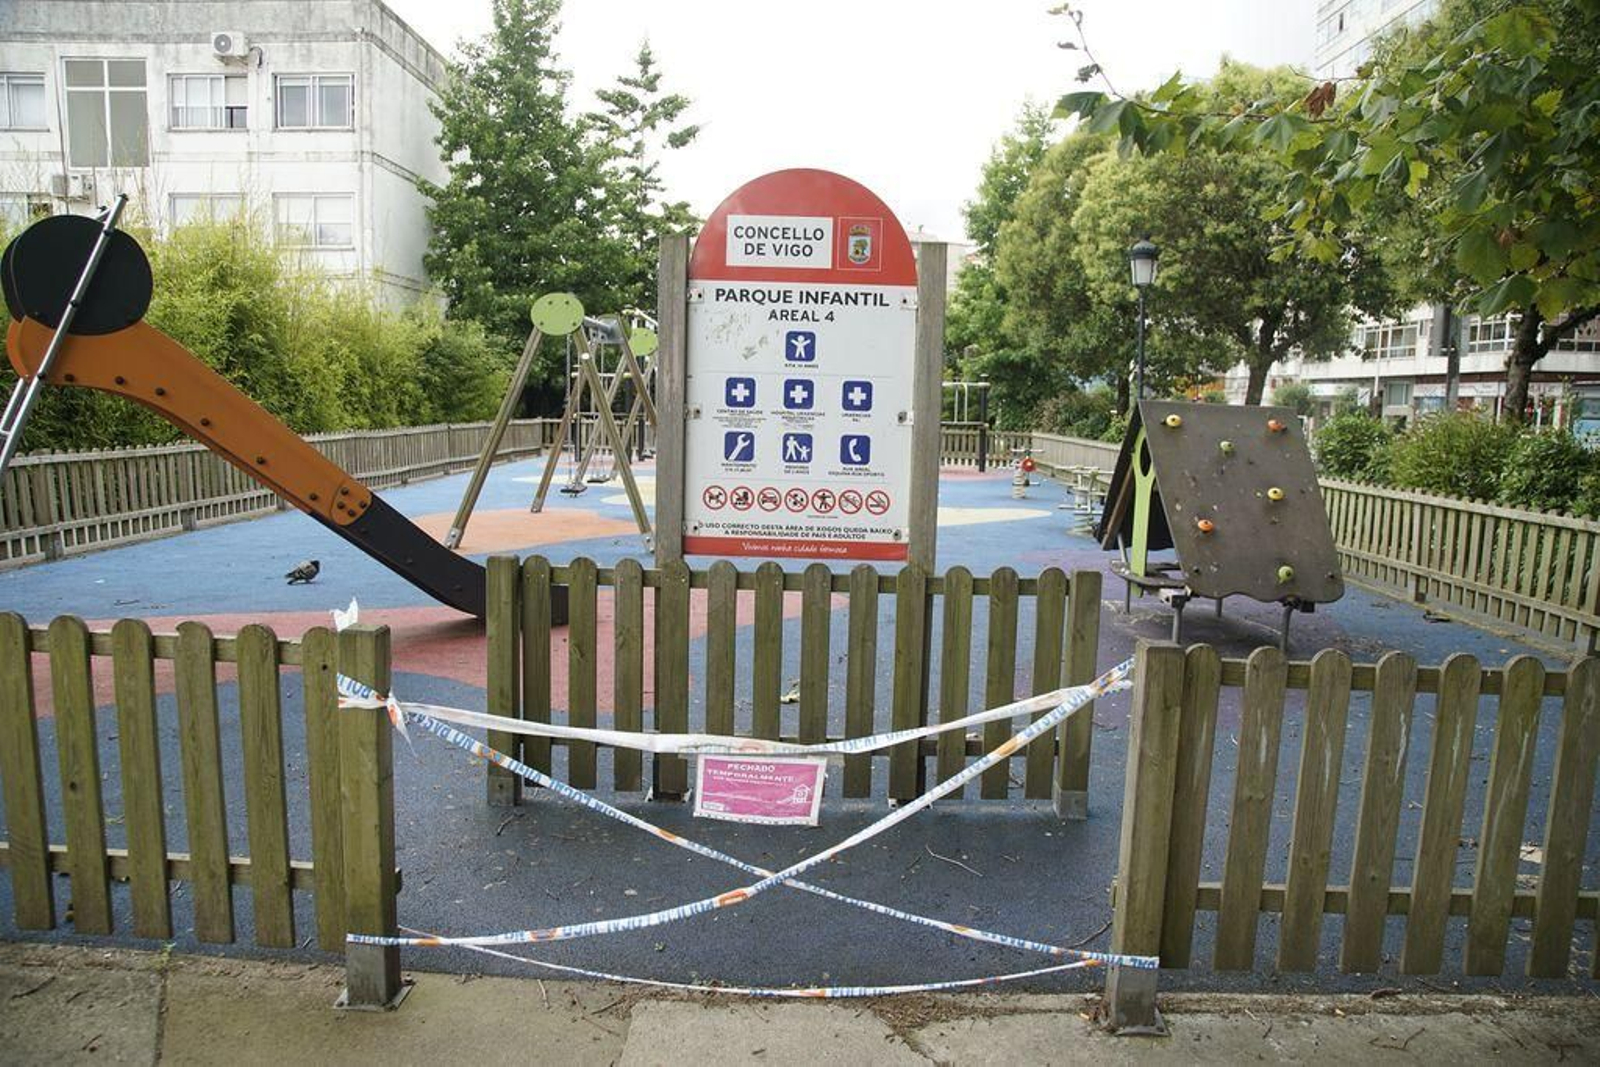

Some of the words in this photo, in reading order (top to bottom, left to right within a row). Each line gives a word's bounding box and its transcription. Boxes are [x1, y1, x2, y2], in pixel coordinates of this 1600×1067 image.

[733, 225, 825, 242] CONCELLO
[744, 242, 766, 257] DE
[772, 243, 814, 258] VIGO
[715, 288, 794, 306] PARQUE
[799, 290, 890, 307] INFANTIL
[768, 309, 820, 322] AREAL
[824, 310, 836, 322] 4
[721, 522, 760, 530] CORRECTO
[731, 529, 799, 538] RESPONSABILIDADE
[832, 532, 866, 540] ADULTOS
[707, 768, 797, 783] TEMPORALMENTE
